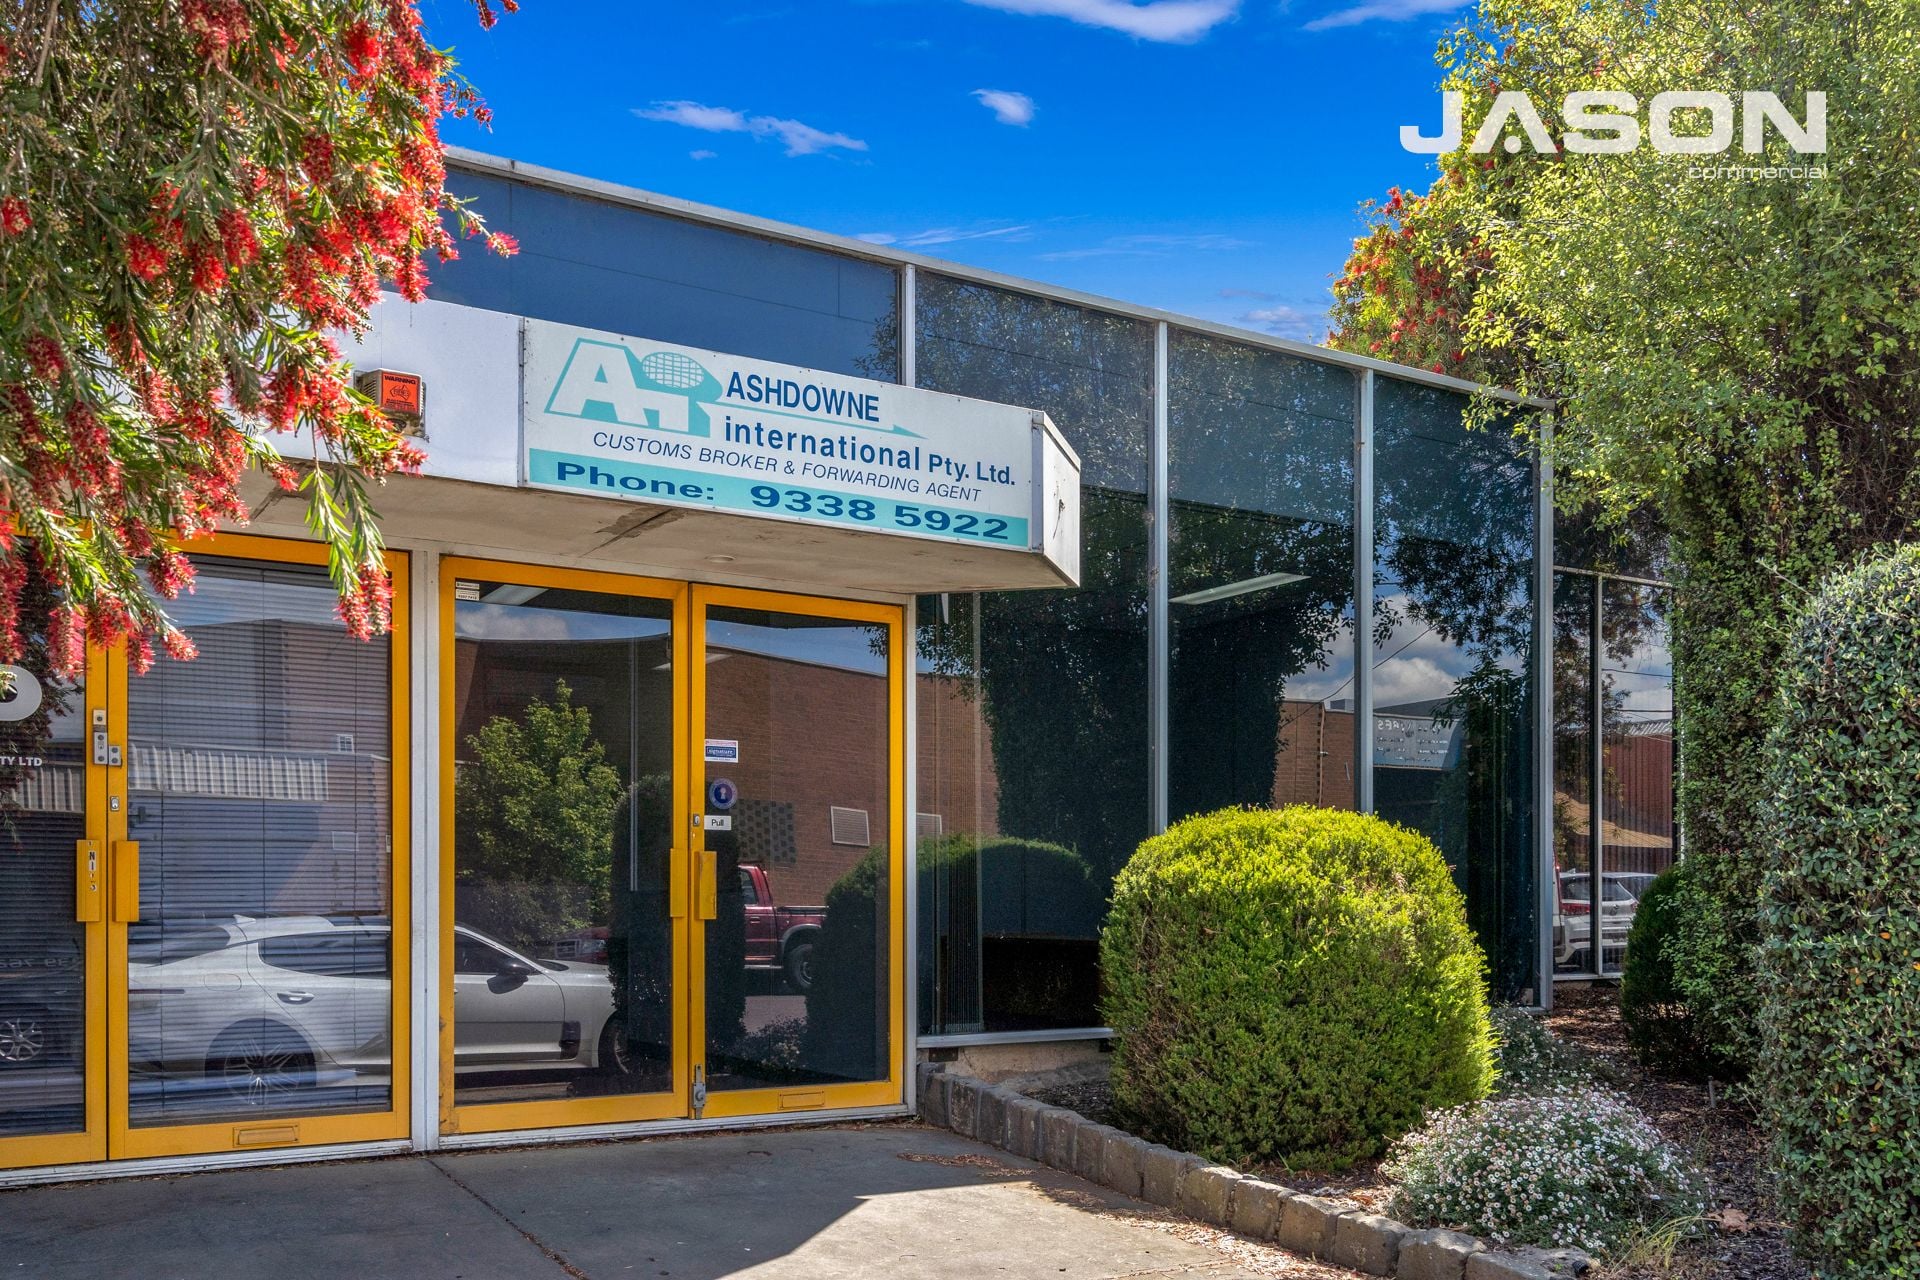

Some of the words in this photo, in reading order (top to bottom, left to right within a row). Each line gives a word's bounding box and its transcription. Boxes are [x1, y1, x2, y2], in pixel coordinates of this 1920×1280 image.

[726, 371, 880, 422] ASHDOWNE
[593, 431, 692, 460] CUSTOMS
[698, 447, 778, 473] BROKER
[783, 460, 795, 475] &
[801, 462, 920, 493] FORWARDING
[926, 482, 981, 502] AGENT
[725, 415, 920, 471] international
[929, 453, 970, 482] Pty.
[976, 461, 1016, 486] Ltd.
[557, 461, 714, 500] Phone:
[750, 485, 876, 521] 9338
[895, 504, 1009, 540] 5922
[19, 757, 43, 767] LTD
[711, 818, 725, 827] Pull
